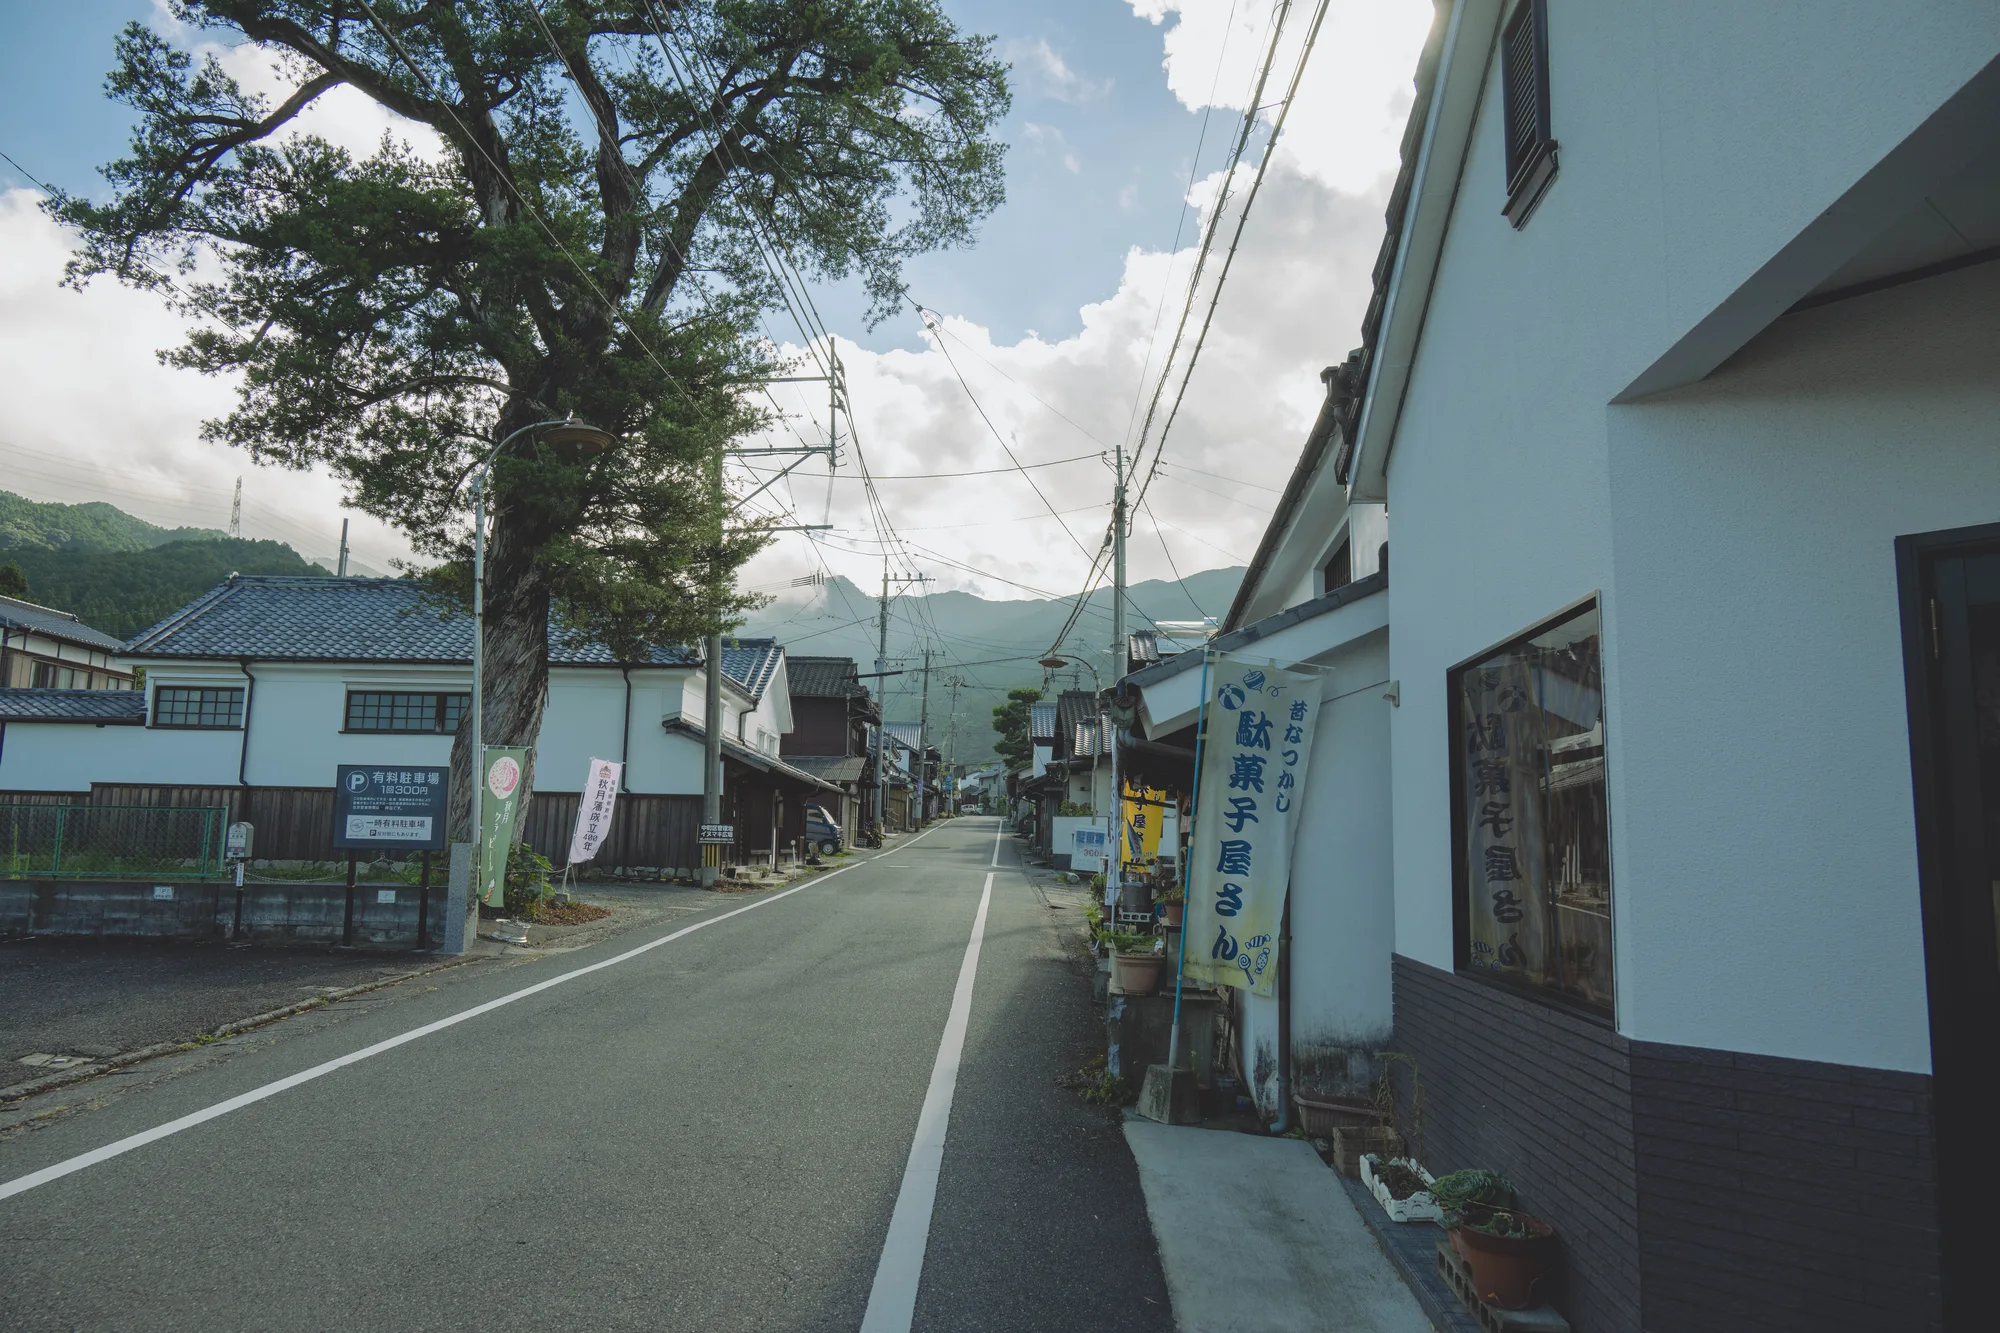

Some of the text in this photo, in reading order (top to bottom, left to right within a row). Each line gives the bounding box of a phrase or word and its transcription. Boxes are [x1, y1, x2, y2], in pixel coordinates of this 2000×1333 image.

[1275, 699, 1308, 814] 昔なつかし
[351, 774, 365, 790] P
[372, 771, 440, 785] 有料駐車場
[381, 785, 428, 795] 1回300円
[501, 800, 513, 825] 秋月
[583, 778, 609, 852] 秋月藩成立400年
[366, 819, 426, 829] 一時有料駐車場
[1212, 710, 1274, 962] 駄菓子屋さん
